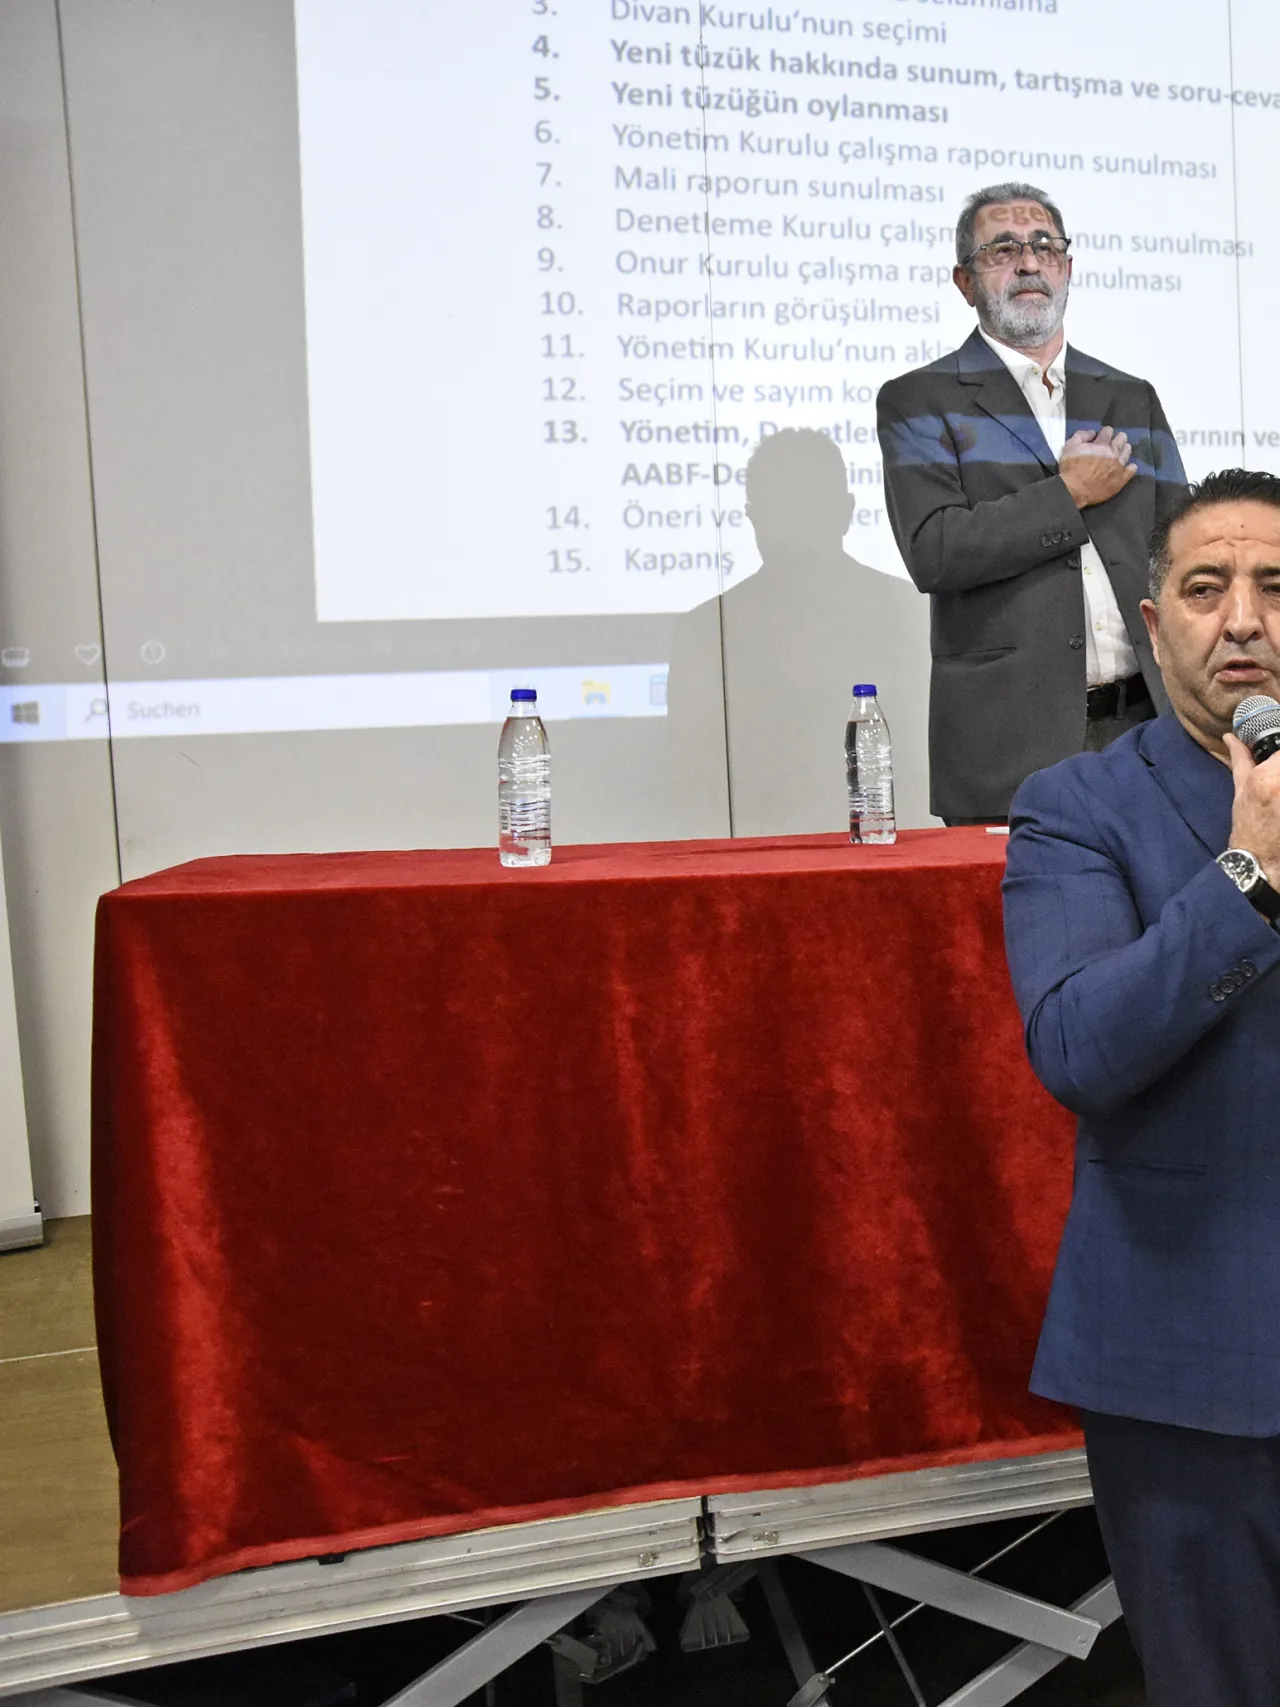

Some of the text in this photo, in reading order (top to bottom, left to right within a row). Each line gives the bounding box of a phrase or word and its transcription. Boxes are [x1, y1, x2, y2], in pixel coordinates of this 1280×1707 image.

[532, 0, 558, 16] 3.
[611, 0, 691, 25] Divan
[863, 18, 947, 46] seçimi
[532, 34, 560, 59] 4.
[611, 38, 672, 67] Yeni
[681, 44, 760, 72] tüzük
[770, 47, 898, 81] hakkında
[907, 62, 1006, 92] sunum,
[1015, 67, 1122, 99] tartışma
[1131, 80, 1160, 100] ve
[533, 77, 948, 125] 5. Yeni tüzüğün oylanması
[534, 119, 1217, 180] 6. Yönetim Kurulu çalışma raporunun sunulması
[536, 162, 944, 204] 7. Mali raporun sunulması
[536, 205, 563, 231] 8.
[616, 207, 773, 238] Denetleme
[783, 212, 871, 242] Kurulu
[880, 217, 957, 248] çalışm
[1131, 230, 1254, 258] sunulması
[537, 247, 564, 274] 9.
[616, 249, 689, 277] Onur
[699, 252, 789, 280] Kurulu
[798, 255, 900, 287] çalışma
[1070, 265, 1182, 292] unulması
[540, 290, 941, 327] 10. Raporların görüşülmesi
[541, 333, 585, 359] 11.
[617, 333, 734, 362] Yönetim
[542, 376, 586, 402] 12.
[619, 377, 703, 408] Seçim
[713, 385, 744, 403] ve
[754, 384, 832, 408] sayım
[543, 419, 588, 445] 13.
[620, 418, 749, 447] Yönetim,
[546, 499, 744, 531] 14. Öneri ve
[547, 547, 735, 577] 15. Kapanış
[127, 699, 201, 720] Suchen
